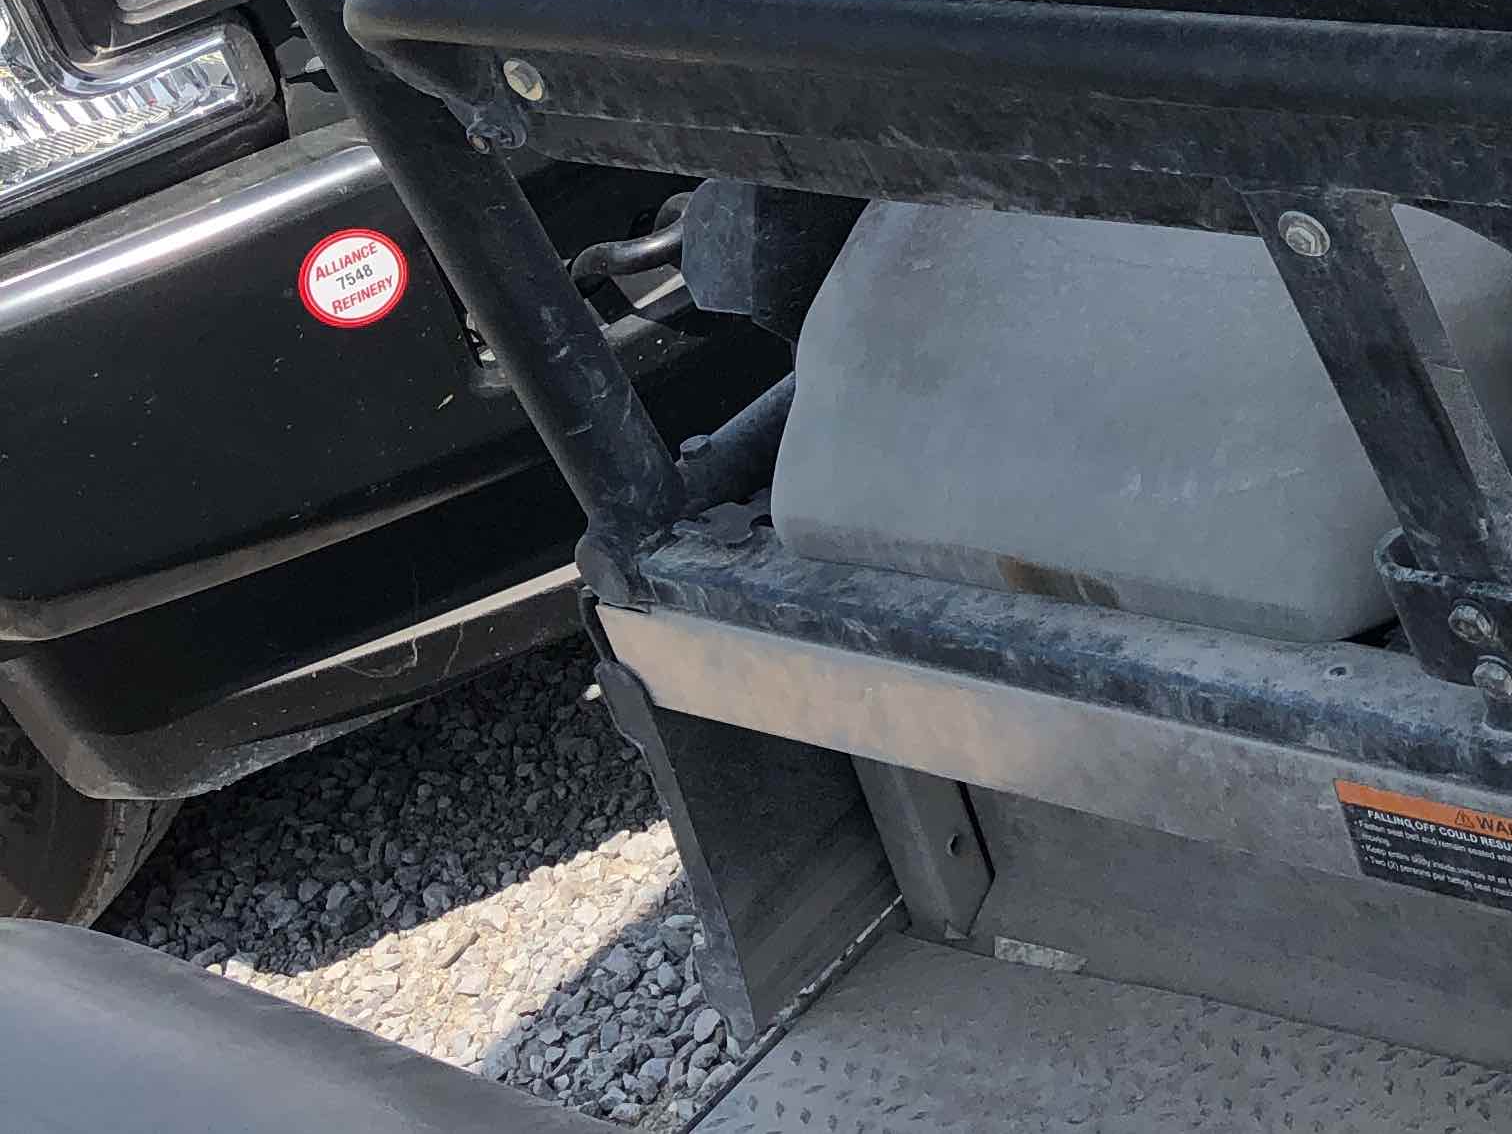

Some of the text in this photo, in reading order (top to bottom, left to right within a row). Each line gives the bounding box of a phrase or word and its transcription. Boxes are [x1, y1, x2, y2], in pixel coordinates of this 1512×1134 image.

[315, 241, 378, 281] ALLIANCE
[336, 264, 374, 291] 7548
[332, 275, 393, 315] REFINERY
[1366, 809, 1415, 830] FALLING
[1413, 820, 1437, 835] OFF
[1437, 825, 1479, 844] COULD
